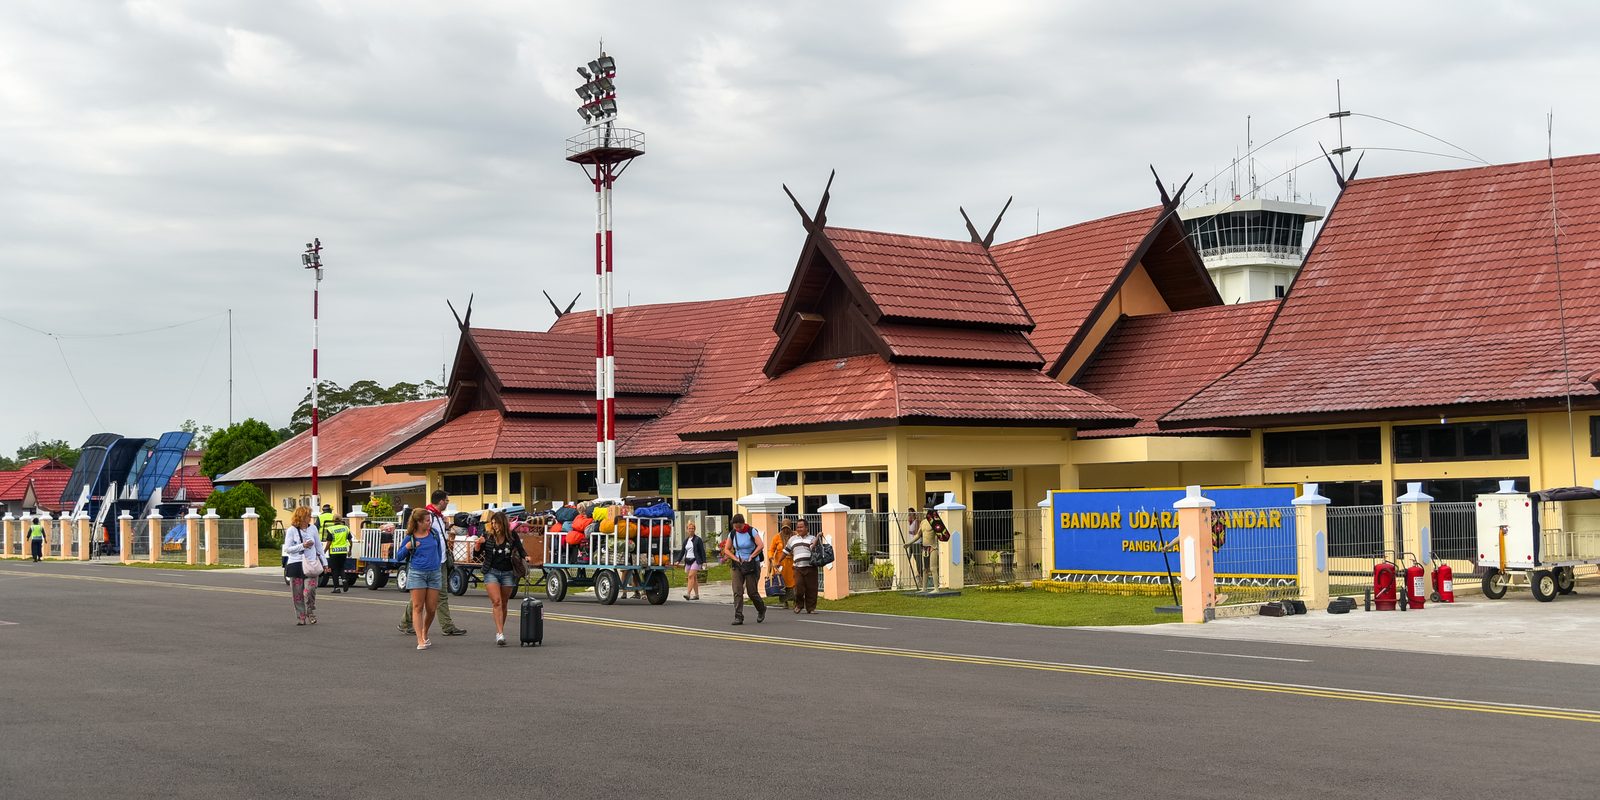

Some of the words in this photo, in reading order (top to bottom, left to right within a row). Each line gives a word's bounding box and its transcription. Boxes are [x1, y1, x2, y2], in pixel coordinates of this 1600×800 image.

[1060, 512, 1121, 529] BANDAR
[1128, 511, 1180, 529] UDARA
[1224, 510, 1281, 529] ANDAR
[1122, 540, 1180, 553] PANGKALA
